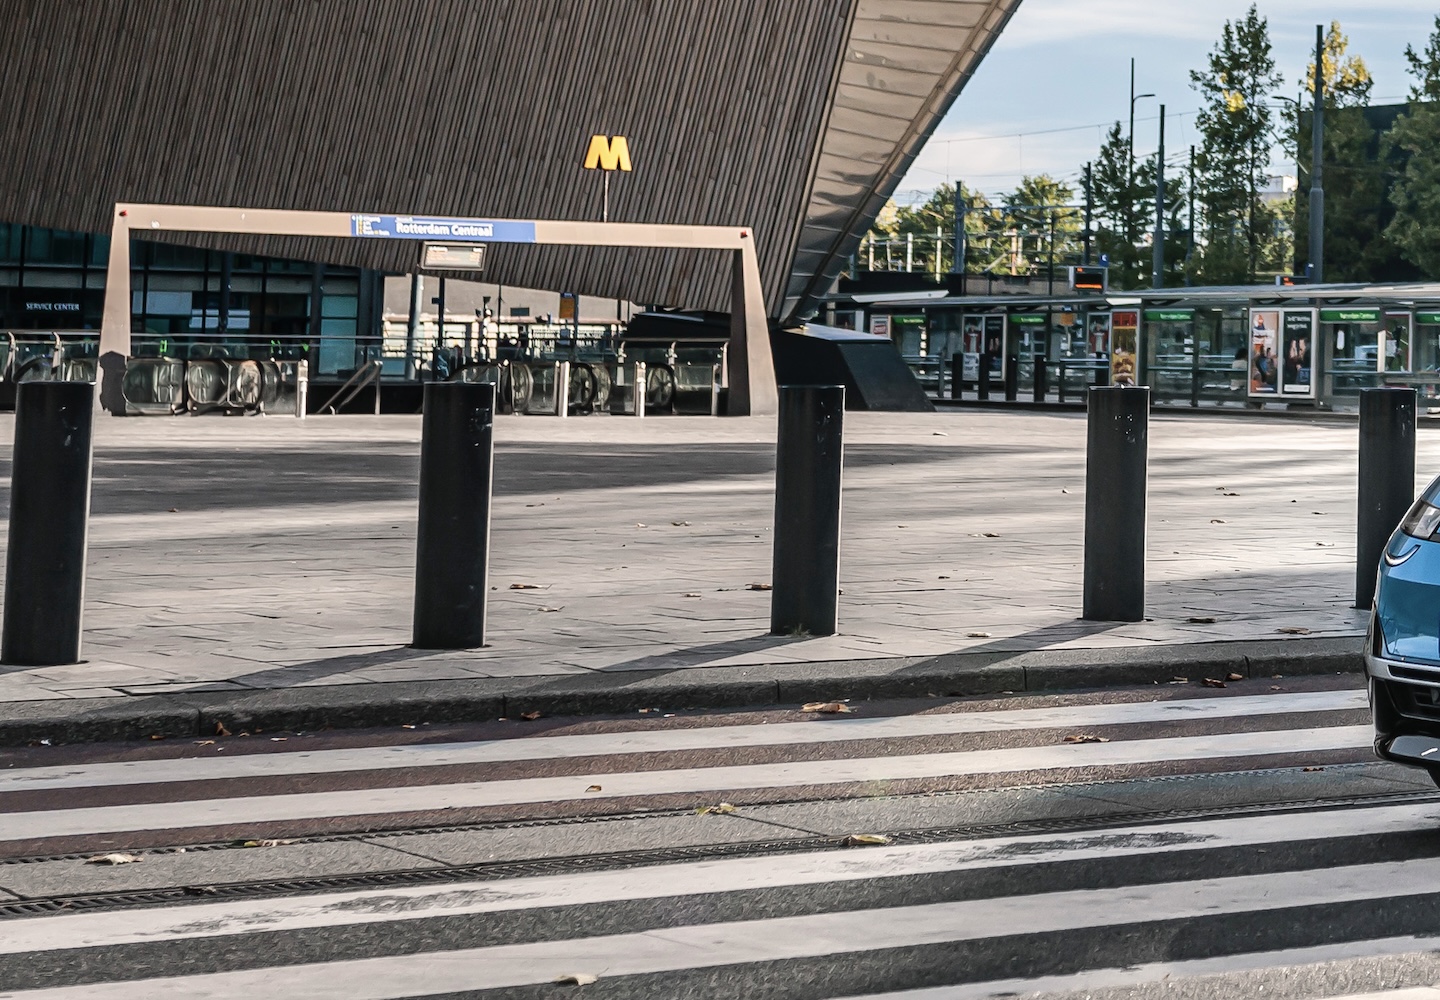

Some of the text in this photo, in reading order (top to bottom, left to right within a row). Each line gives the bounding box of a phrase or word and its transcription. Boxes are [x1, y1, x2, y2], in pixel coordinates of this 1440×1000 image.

[583, 134, 633, 172] M
[396, 222, 450, 236] Rotterdam
[451, 224, 493, 237] Centraal
[26, 302, 80, 311] SERVICE CENTER
